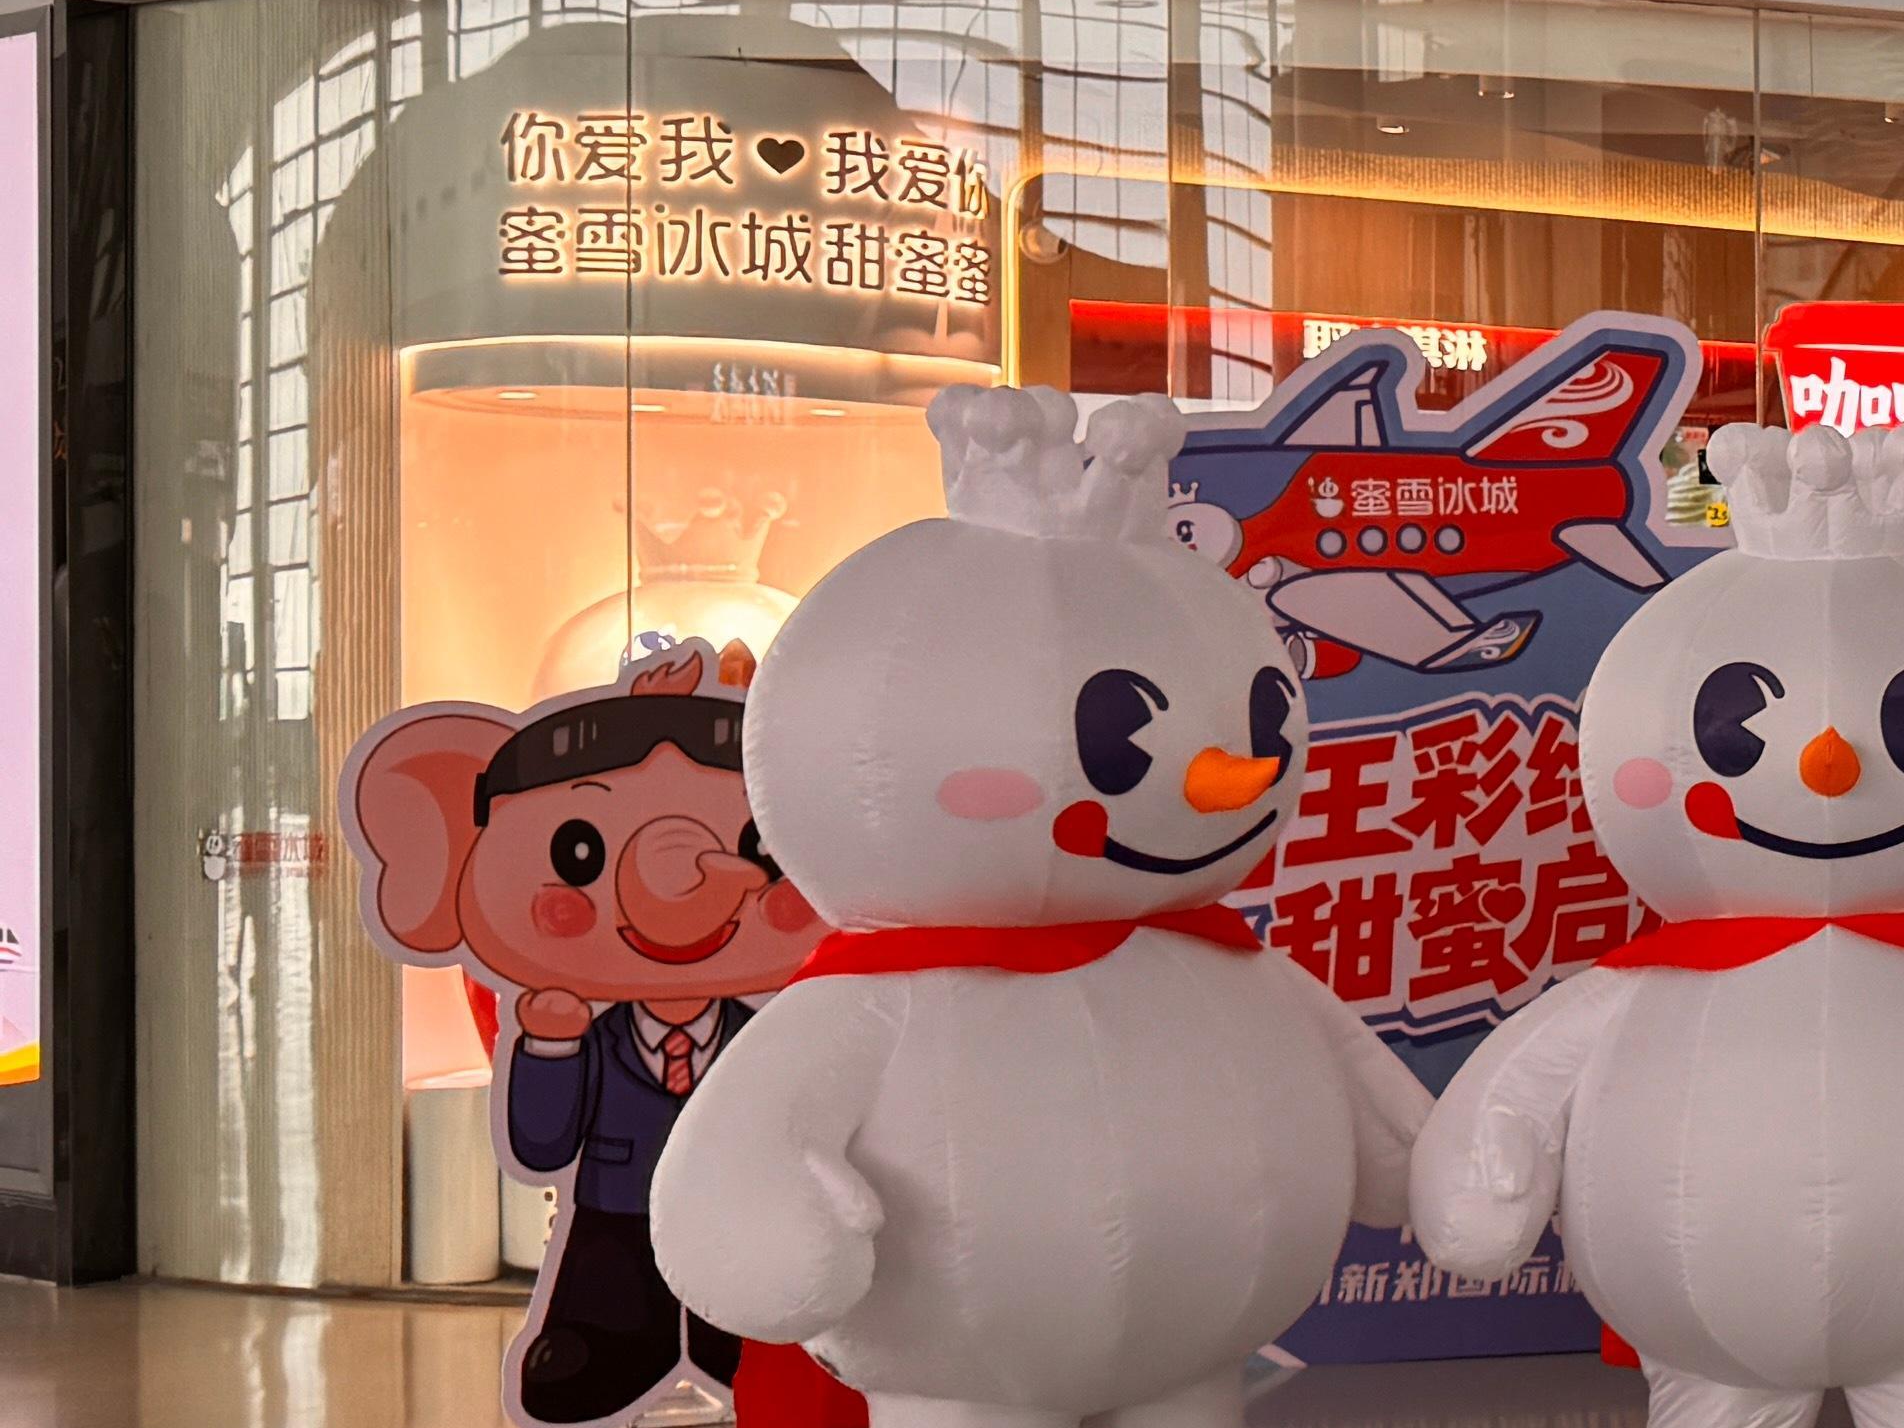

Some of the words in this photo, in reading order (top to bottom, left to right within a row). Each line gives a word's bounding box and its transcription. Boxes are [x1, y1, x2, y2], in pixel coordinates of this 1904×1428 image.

[500, 111, 734, 185] 你爱我
[825, 128, 990, 221] 我爱你
[499, 203, 992, 306] 蜜雪冰城甜蜜蜜
[1350, 475, 1519, 517] 蜜雪冰城
[1265, 841, 1664, 1002] 甜蜜启
[1319, 1257, 1582, 1306] 新郑国际
